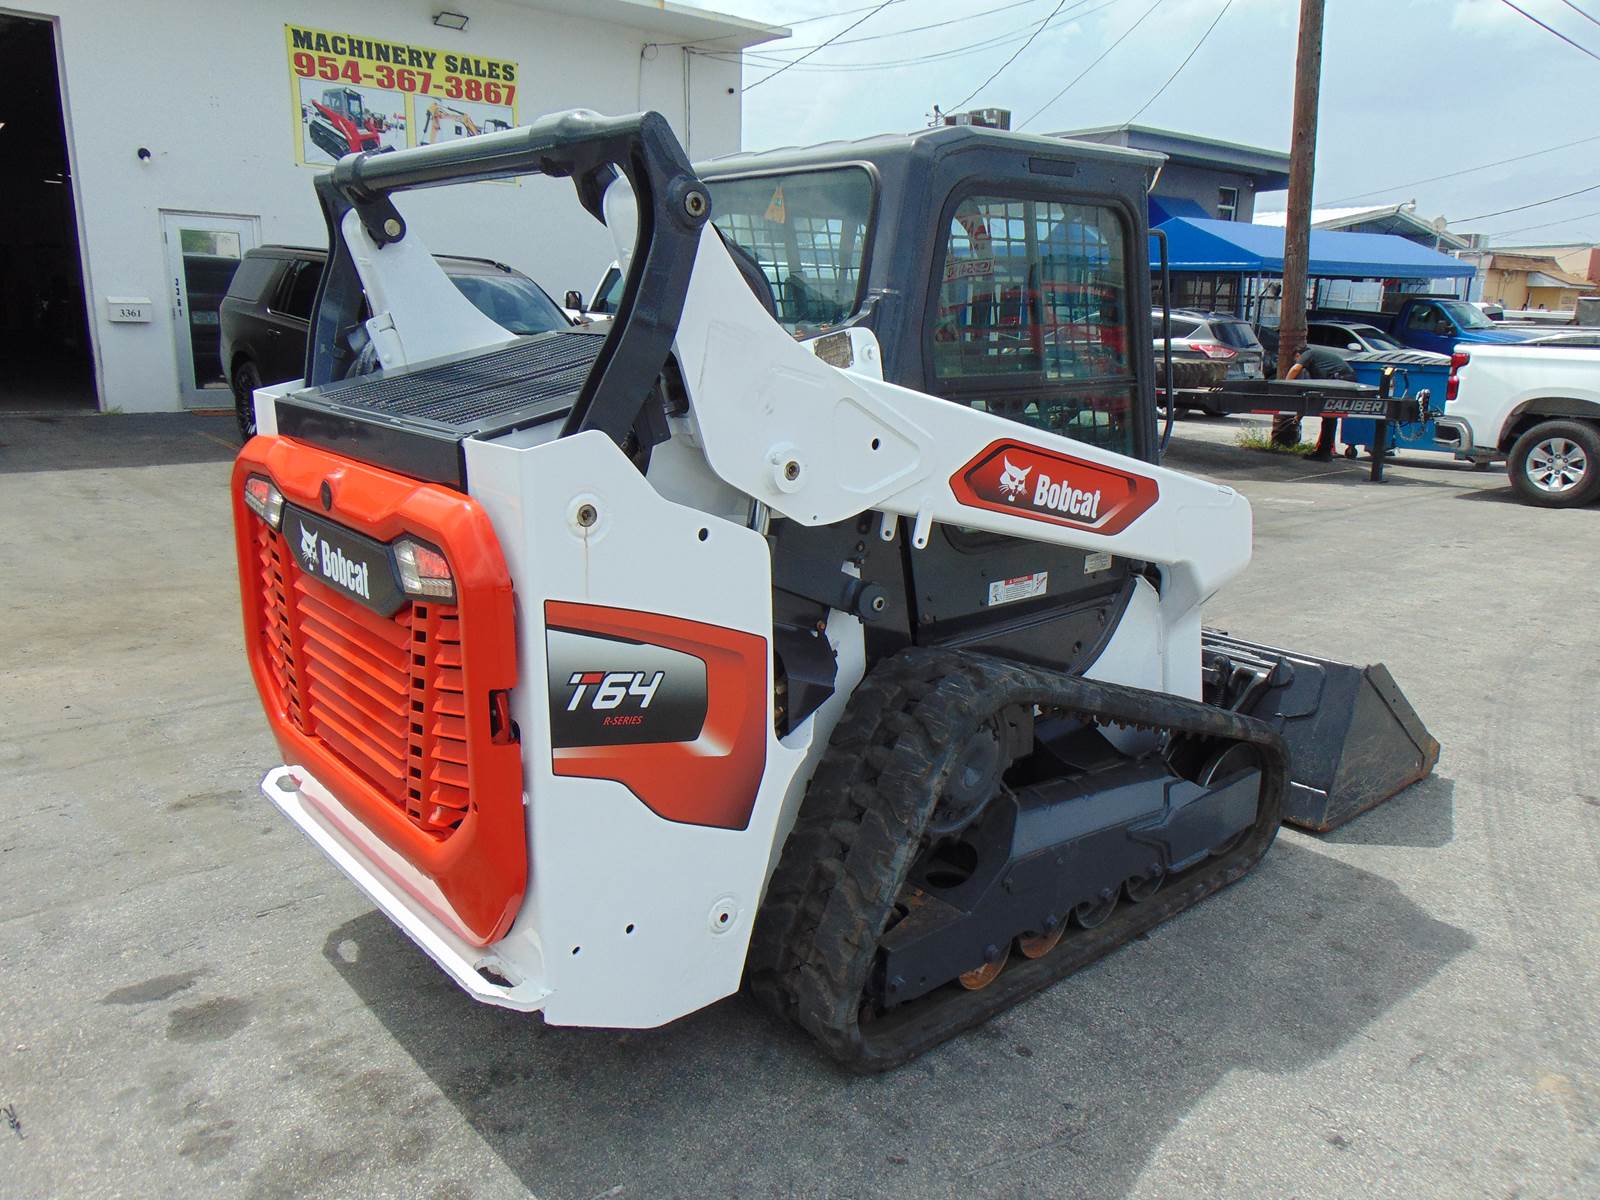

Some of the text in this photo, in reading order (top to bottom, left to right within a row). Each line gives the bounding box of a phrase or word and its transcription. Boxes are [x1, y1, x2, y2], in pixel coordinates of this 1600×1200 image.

[291, 28, 515, 81] MACHINERY SALES
[293, 51, 516, 106] 954-367-3867
[119, 309, 142, 318] 3361
[1323, 398, 1383, 412] CALIBER
[1033, 473, 1101, 519] Bobcat
[320, 540, 370, 599] Bobcat
[567, 671, 665, 711] T64
[603, 715, 643, 726] R-SERIES
